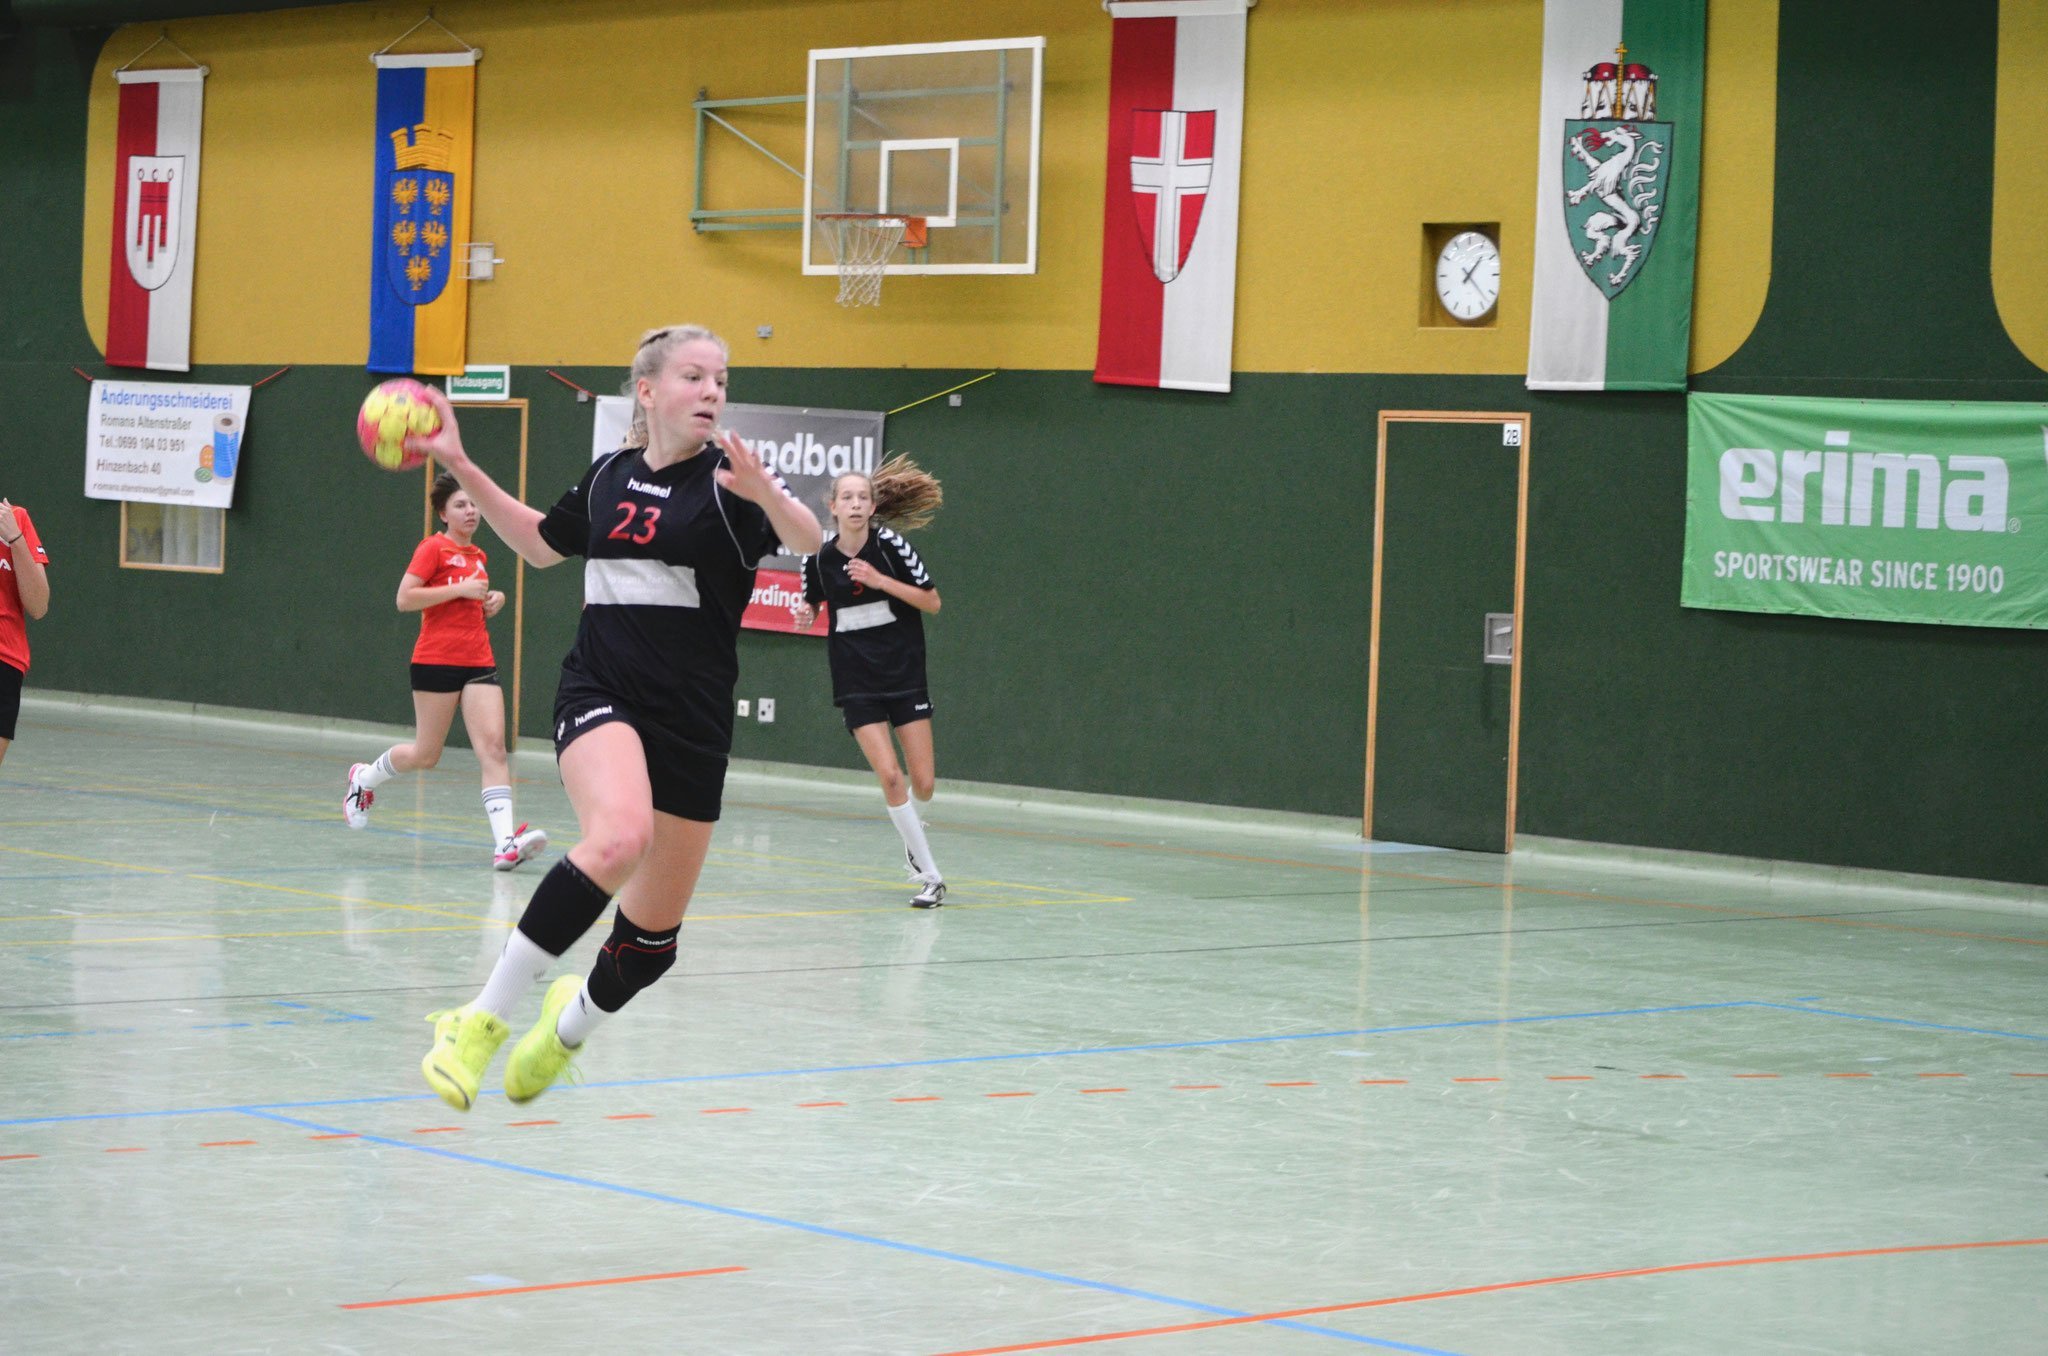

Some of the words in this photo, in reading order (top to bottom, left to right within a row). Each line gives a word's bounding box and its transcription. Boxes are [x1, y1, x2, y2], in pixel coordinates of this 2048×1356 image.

[101, 383, 233, 411] Änderungsschneiderei
[101, 413, 136, 428] Romana
[96, 458, 150, 474] Hinzenbach
[724, 430, 874, 478] ndball
[627, 477, 672, 499] hummel
[1719, 431, 2010, 532] erima
[608, 502, 662, 545] 23
[1714, 551, 1863, 586] SPORTSWEAR
[1871, 560, 1938, 590] SINCE
[1947, 564, 2004, 593] 1900
[575, 705, 613, 727] hummel
